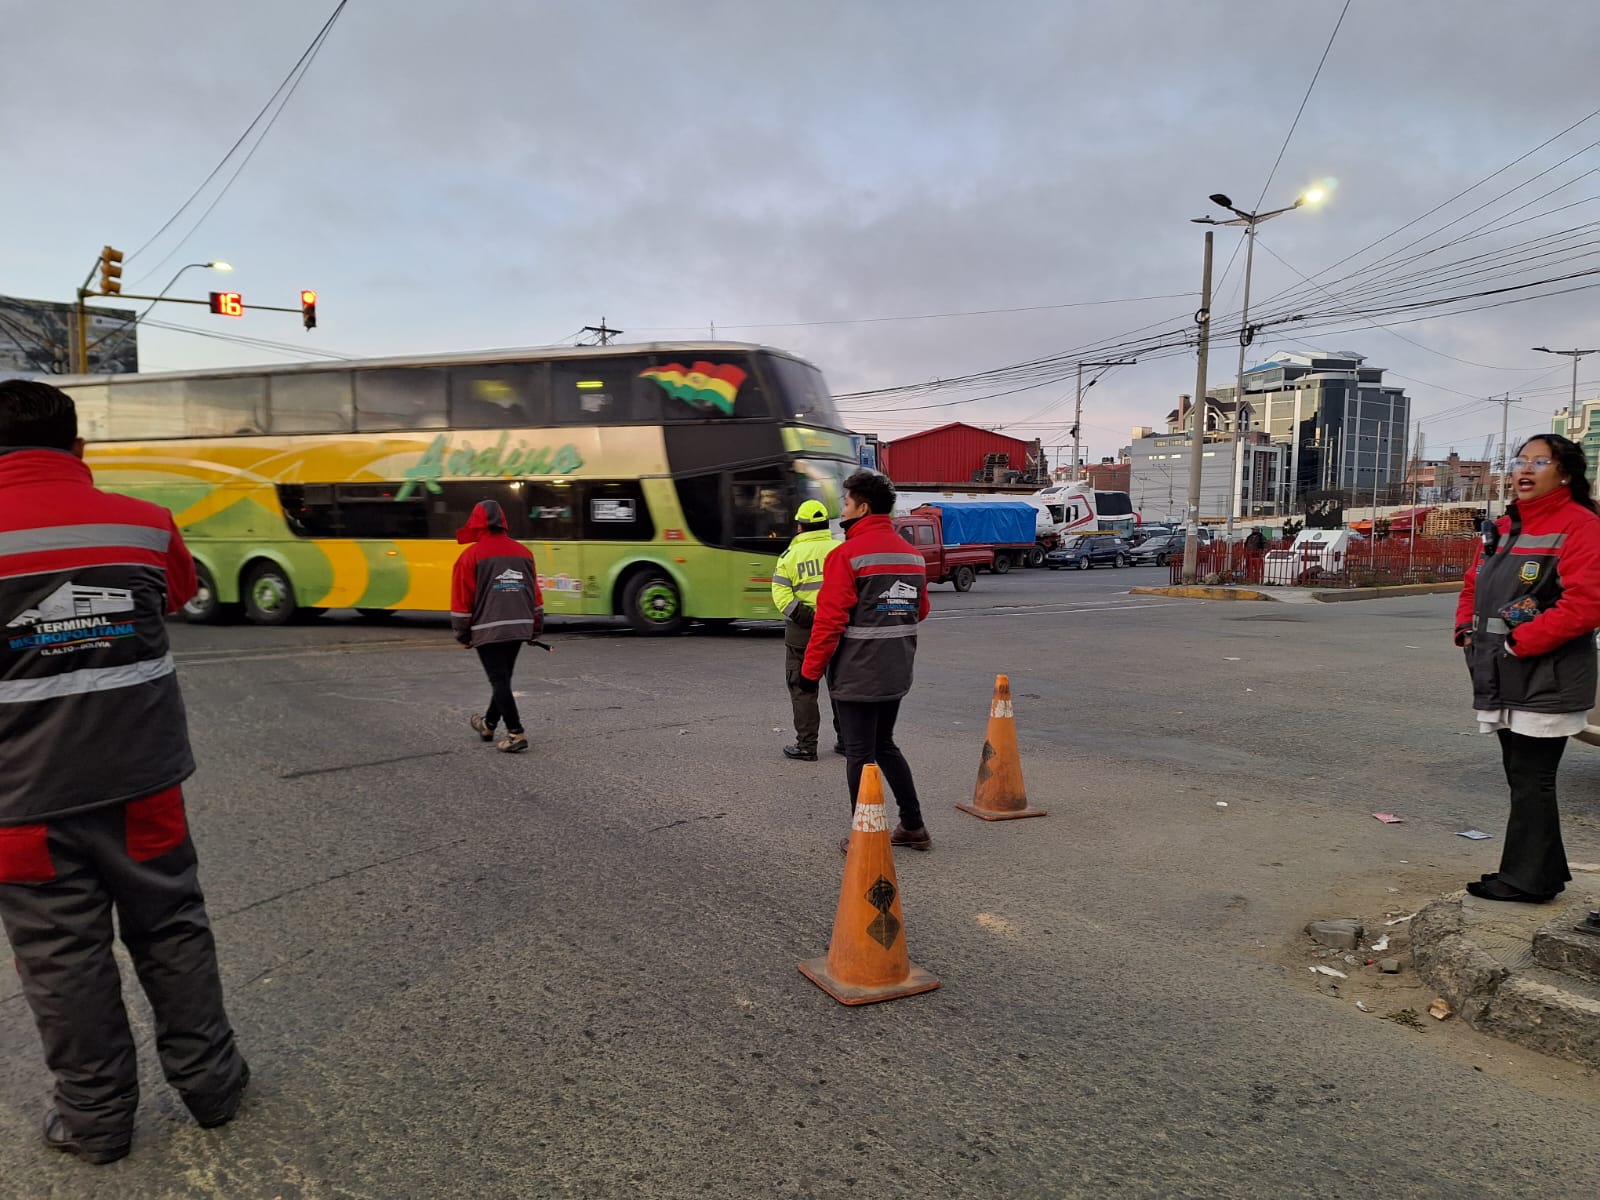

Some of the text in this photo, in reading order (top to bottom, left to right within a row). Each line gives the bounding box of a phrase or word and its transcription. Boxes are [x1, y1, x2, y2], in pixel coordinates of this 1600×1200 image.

[220, 293, 241, 315] 16
[797, 559, 823, 579] POL
[33, 616, 112, 634] TERMINAL
[51, 644, 74, 655] ALTO
